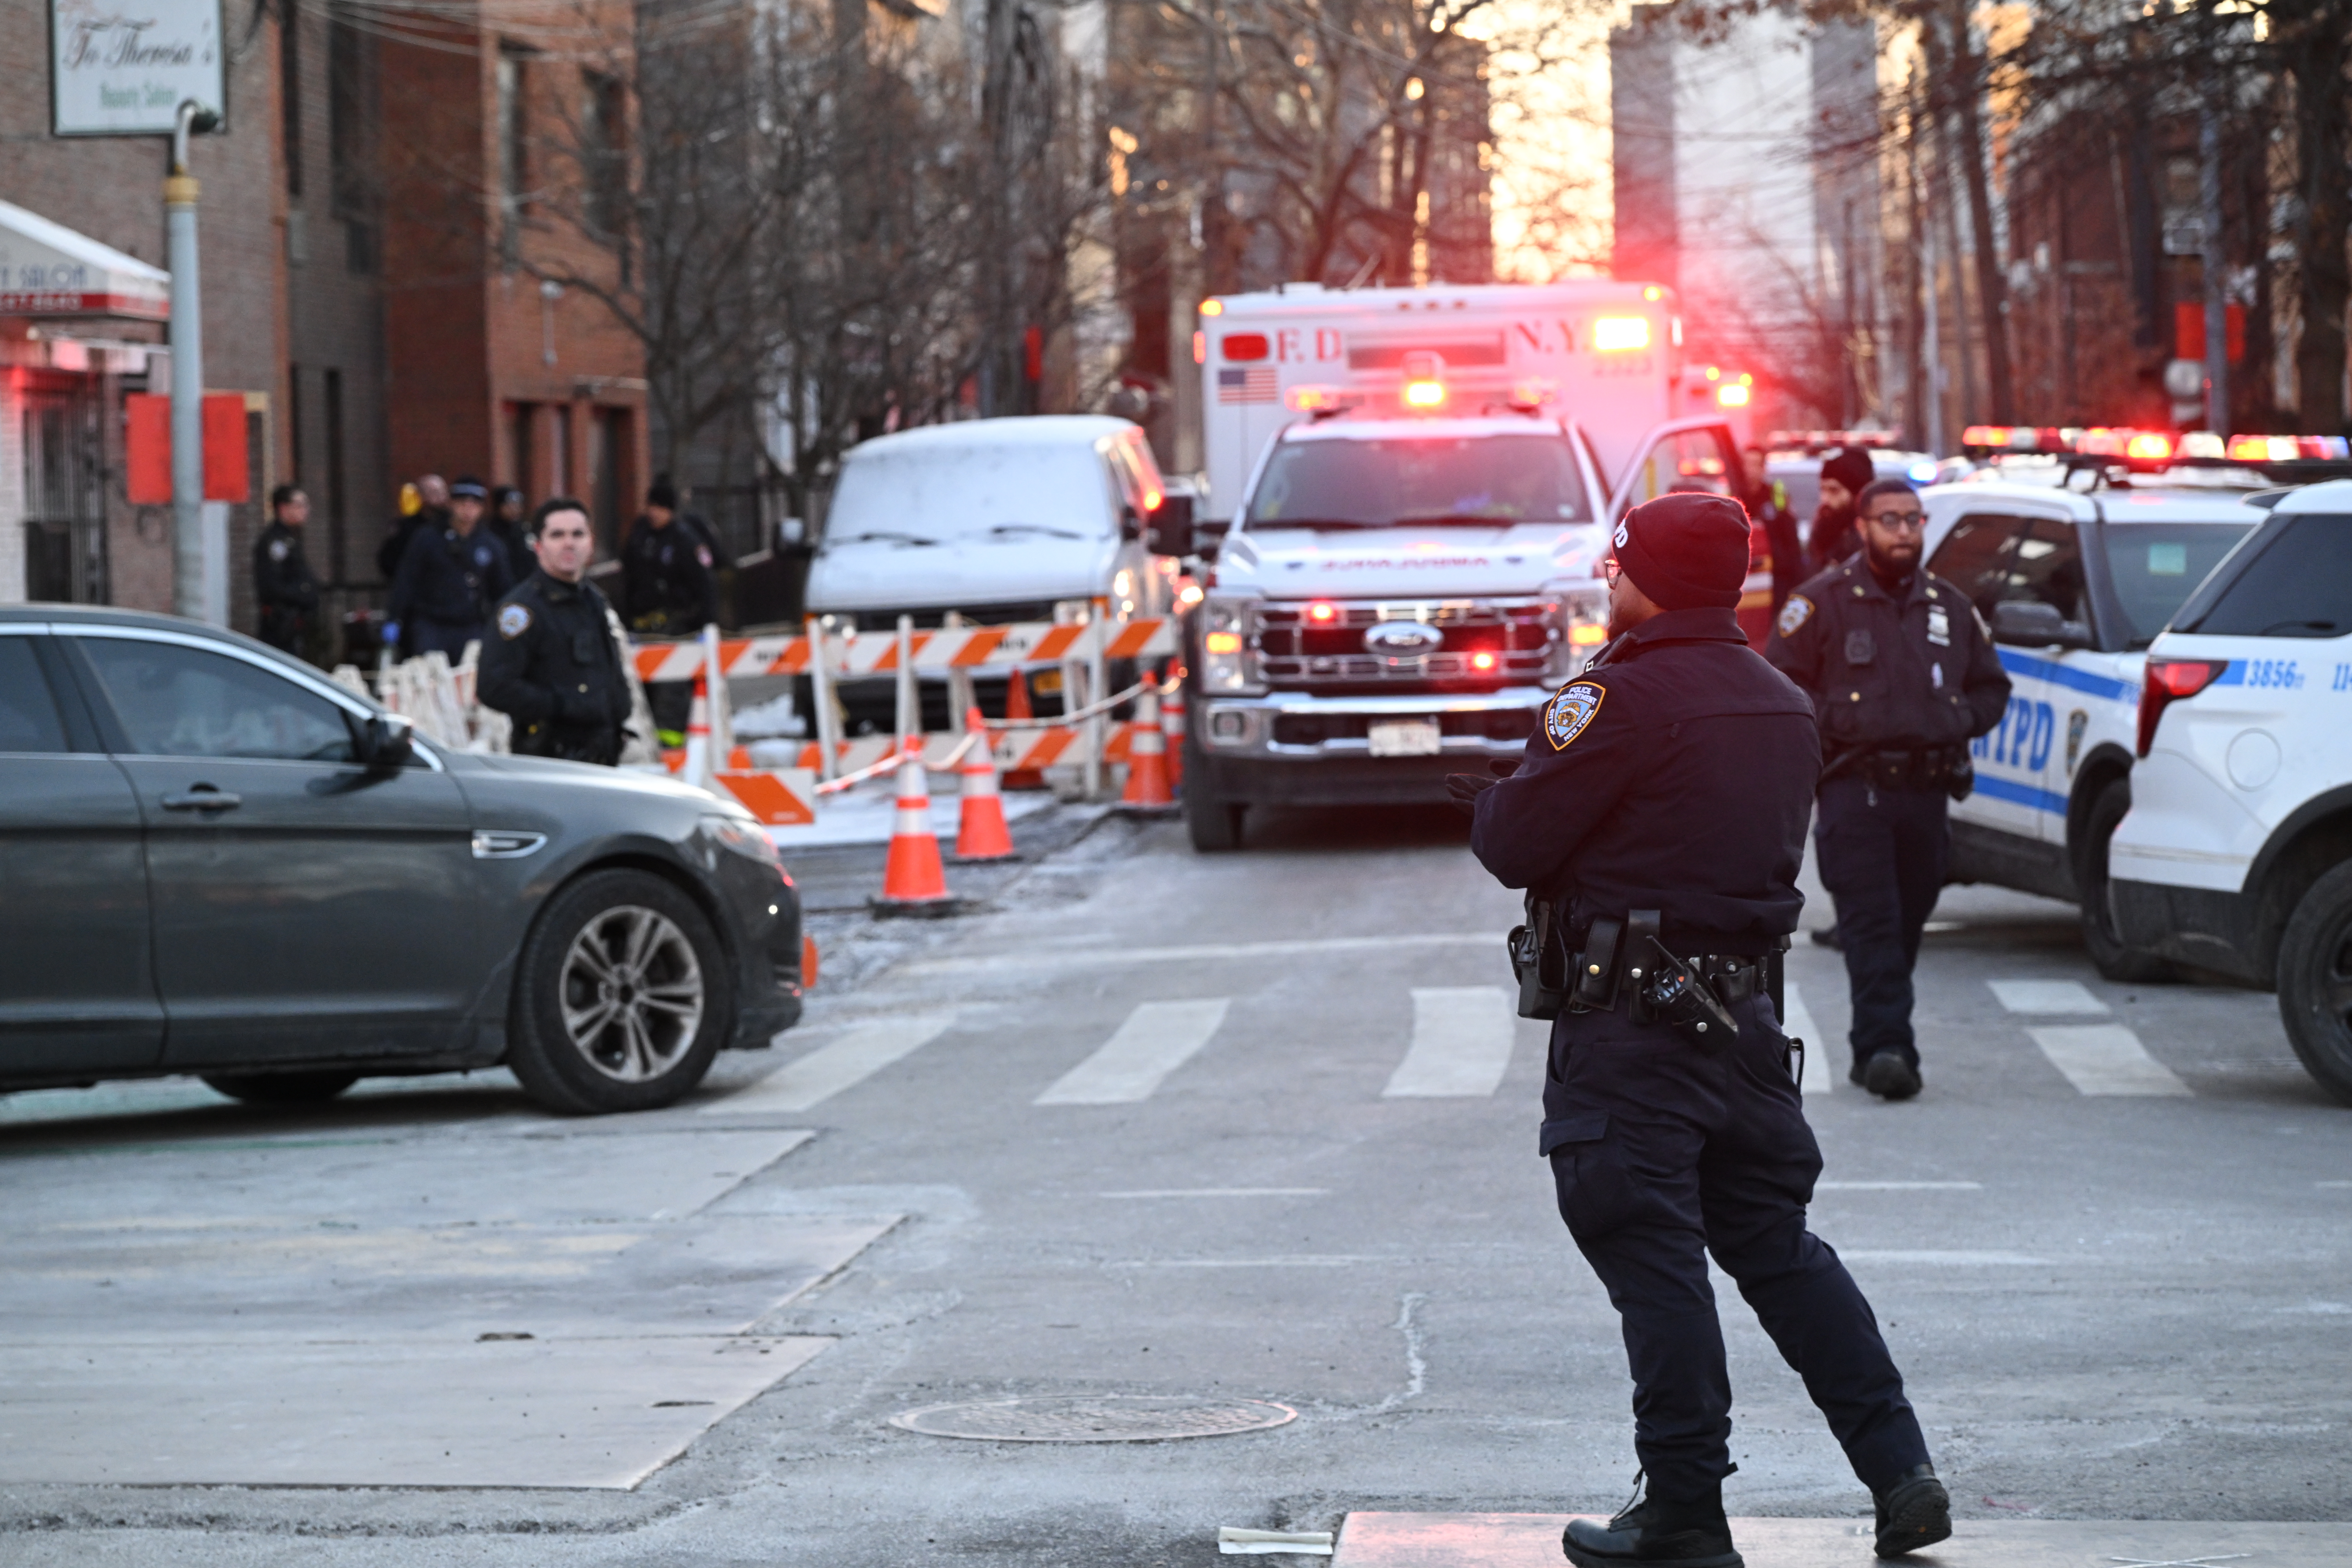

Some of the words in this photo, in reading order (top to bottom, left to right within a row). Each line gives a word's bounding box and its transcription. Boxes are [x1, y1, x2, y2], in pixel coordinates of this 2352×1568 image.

[1568, 686, 1592, 695] POLICE
[1557, 693, 1597, 705] DEPARTMENT
[1549, 725, 1556, 735] OF
[1563, 727, 1578, 742] NEW
[1576, 709, 1595, 728] YORK
